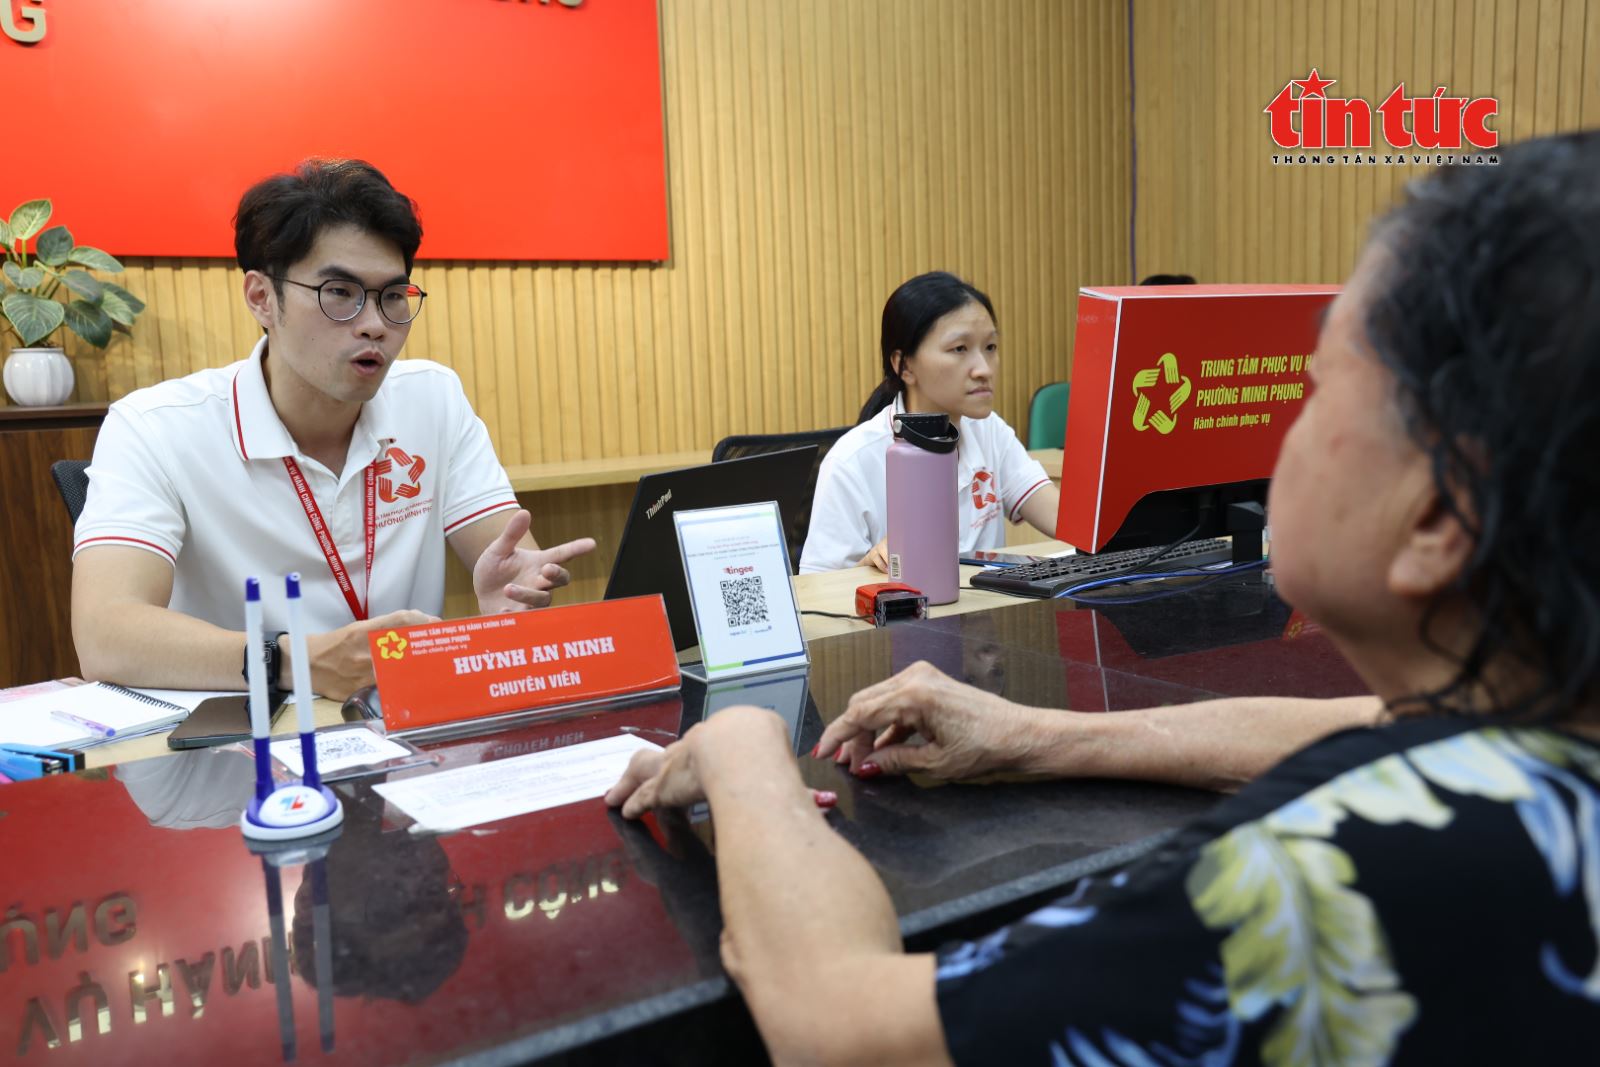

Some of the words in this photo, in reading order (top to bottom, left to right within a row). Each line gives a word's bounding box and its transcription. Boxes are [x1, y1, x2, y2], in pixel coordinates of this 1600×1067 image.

[1200, 358, 1235, 378] TRUNG
[1237, 354, 1259, 375] TÂM
[1261, 355, 1288, 377] PHỤC
[1290, 354, 1303, 376] VỤ
[1196, 384, 1239, 407] PHƯỜNG
[1240, 385, 1268, 403] MINH
[1270, 382, 1304, 404] PHỤNG
[1193, 416, 1214, 430] Hành
[1216, 414, 1239, 428] chính
[1240, 413, 1260, 428] phục
[1261, 413, 1271, 427] vụ
[376, 516, 404, 529] HƯỜNG
[453, 648, 527, 675] HUỲNH
[532, 643, 559, 664] AN
[564, 636, 615, 658] NINH
[489, 674, 546, 697] CHUYÊN
[549, 670, 581, 688] VIÊN
